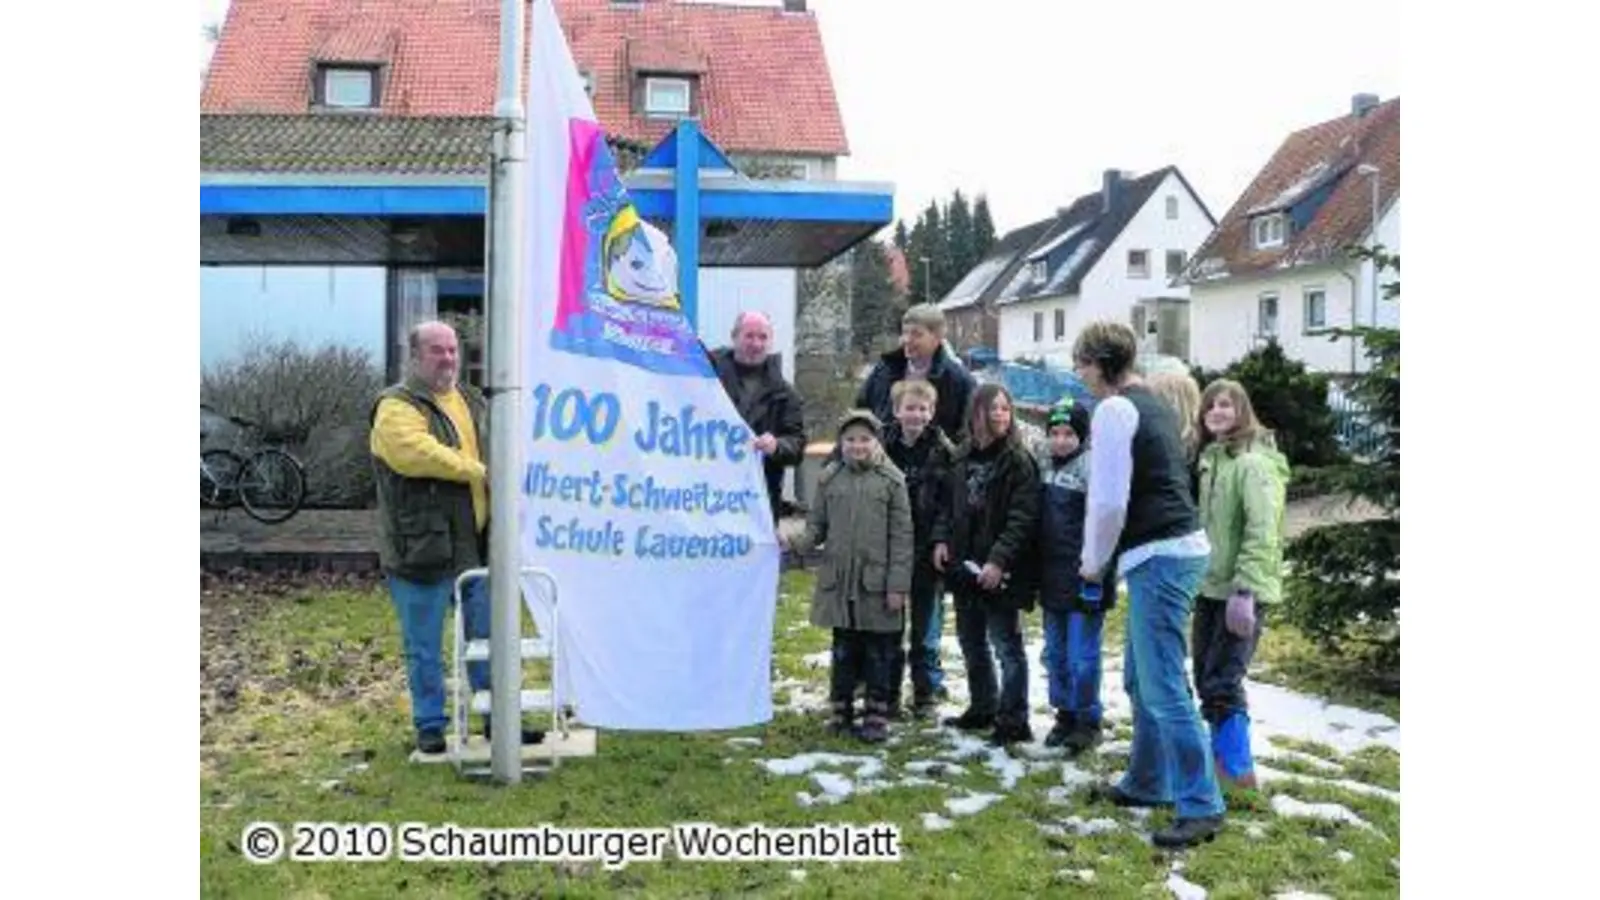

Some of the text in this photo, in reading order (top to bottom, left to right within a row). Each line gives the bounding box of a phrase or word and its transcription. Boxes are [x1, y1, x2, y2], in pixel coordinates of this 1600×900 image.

[532, 382, 749, 462] 100 Jahre
[535, 515, 624, 556] Schule
